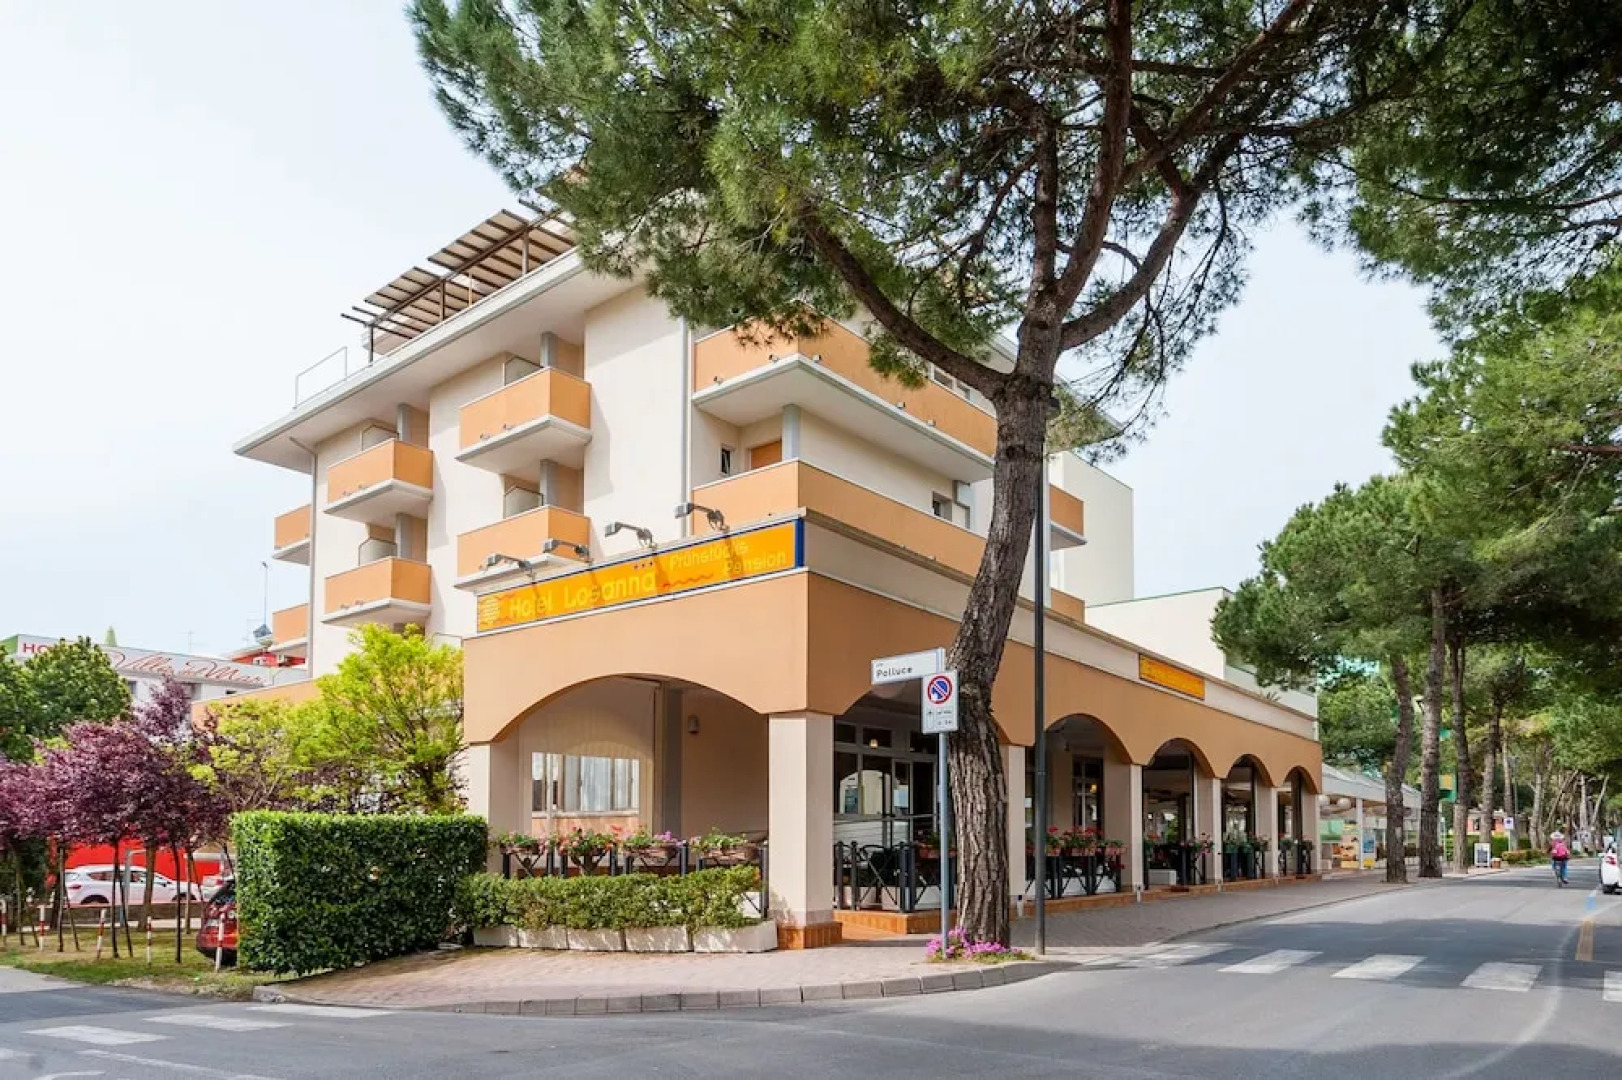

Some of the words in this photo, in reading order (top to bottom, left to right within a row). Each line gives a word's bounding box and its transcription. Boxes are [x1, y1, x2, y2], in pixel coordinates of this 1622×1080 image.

[510, 593, 552, 619] Hotel
[563, 572, 657, 609] Losanna
[876, 667, 912, 677] Polluce
